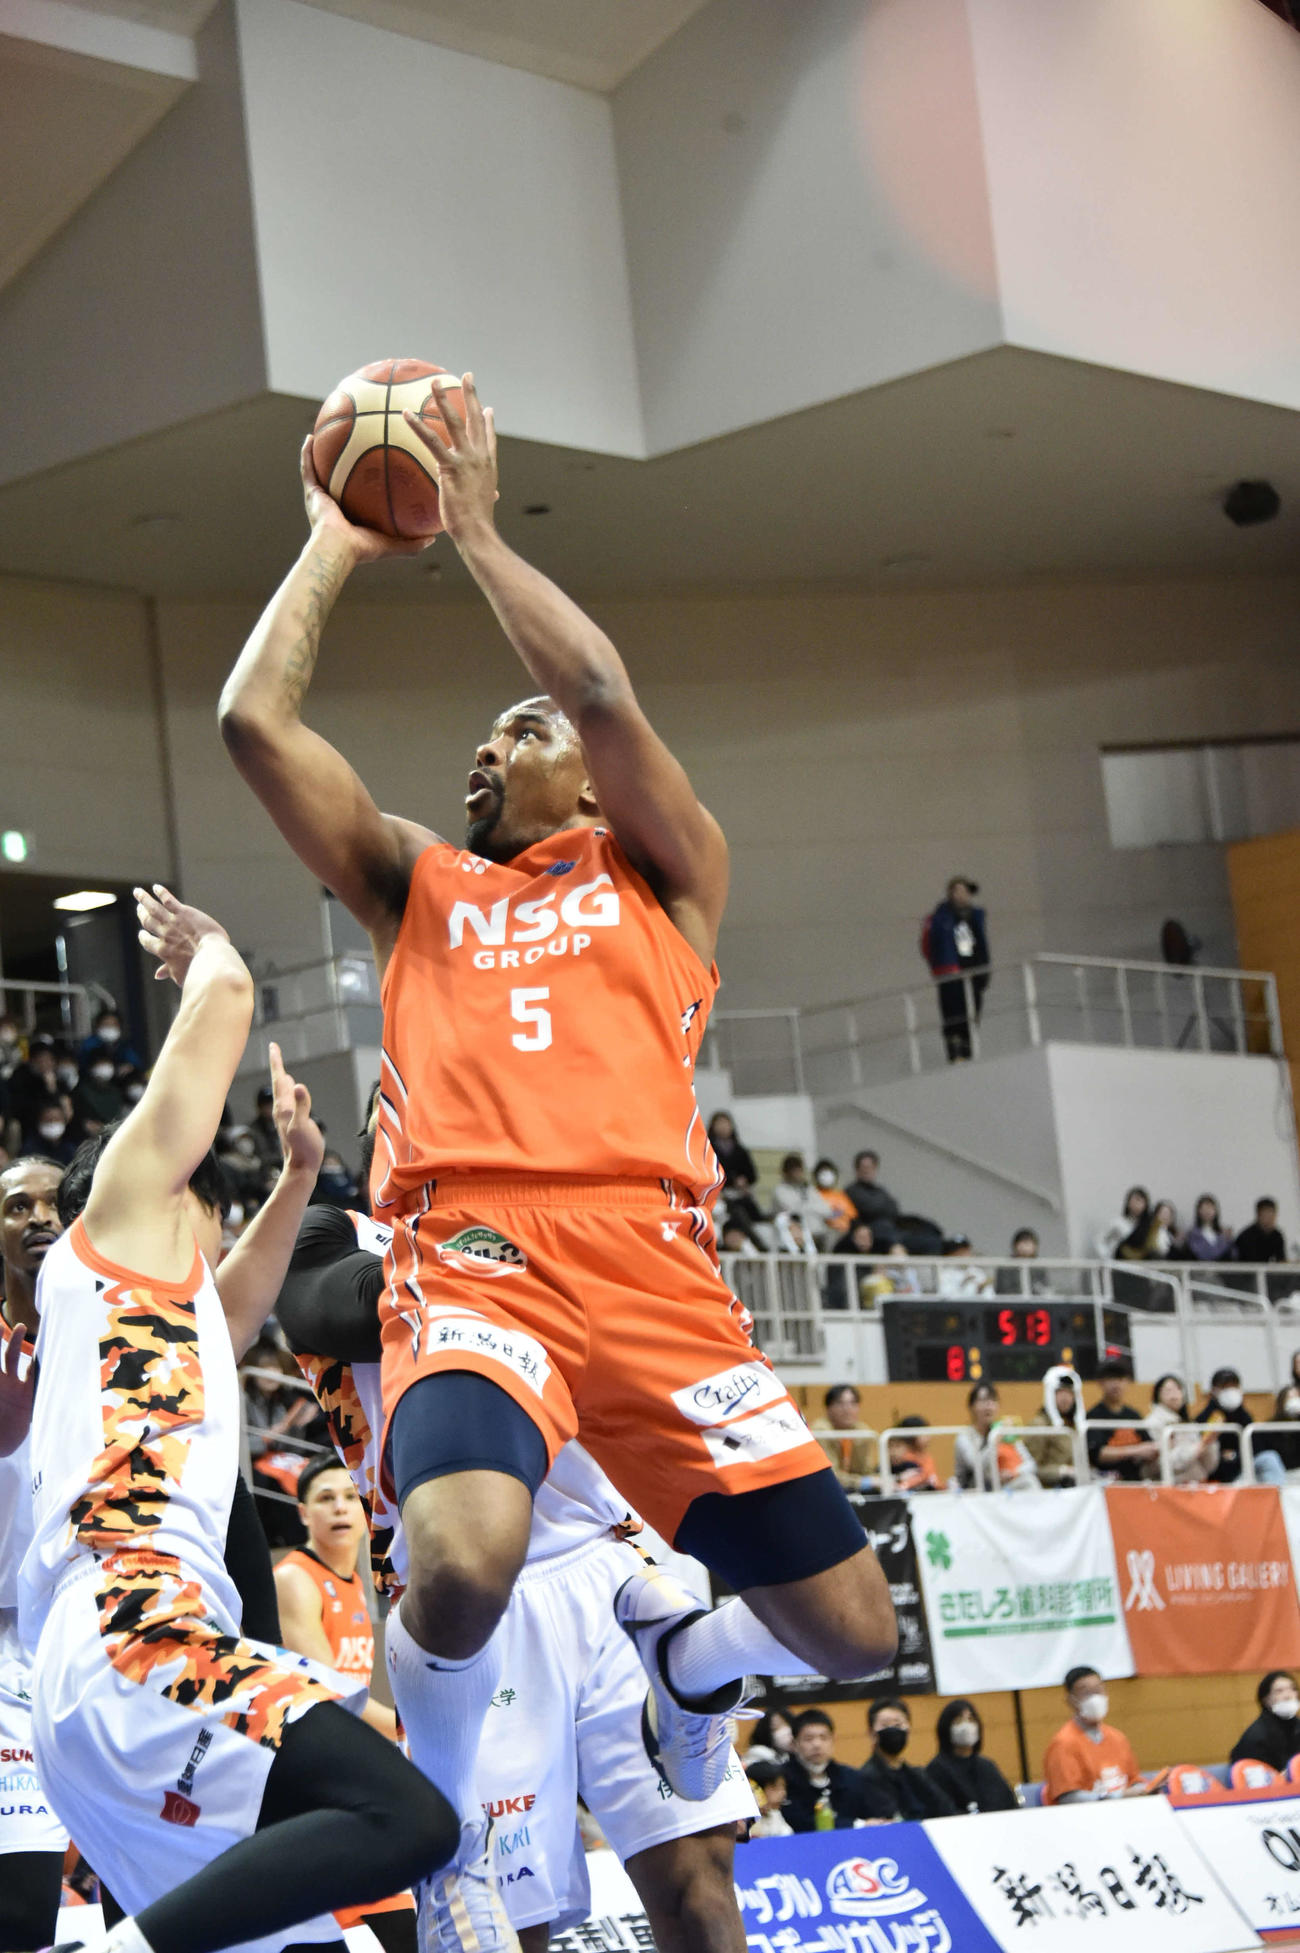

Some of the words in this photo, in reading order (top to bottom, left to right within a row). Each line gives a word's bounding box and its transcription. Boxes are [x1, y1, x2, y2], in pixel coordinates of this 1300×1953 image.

[449, 873, 620, 950] NSG
[473, 933, 591, 969] GROUP
[510, 986, 552, 1052] 5
[693, 1373, 762, 1415] Crafty
[1164, 1561, 1225, 1592] LIVING
[481, 1794, 536, 1818] UKE
[833, 1860, 909, 1894] ASC
[992, 1846, 1205, 1927] 新潟日報
